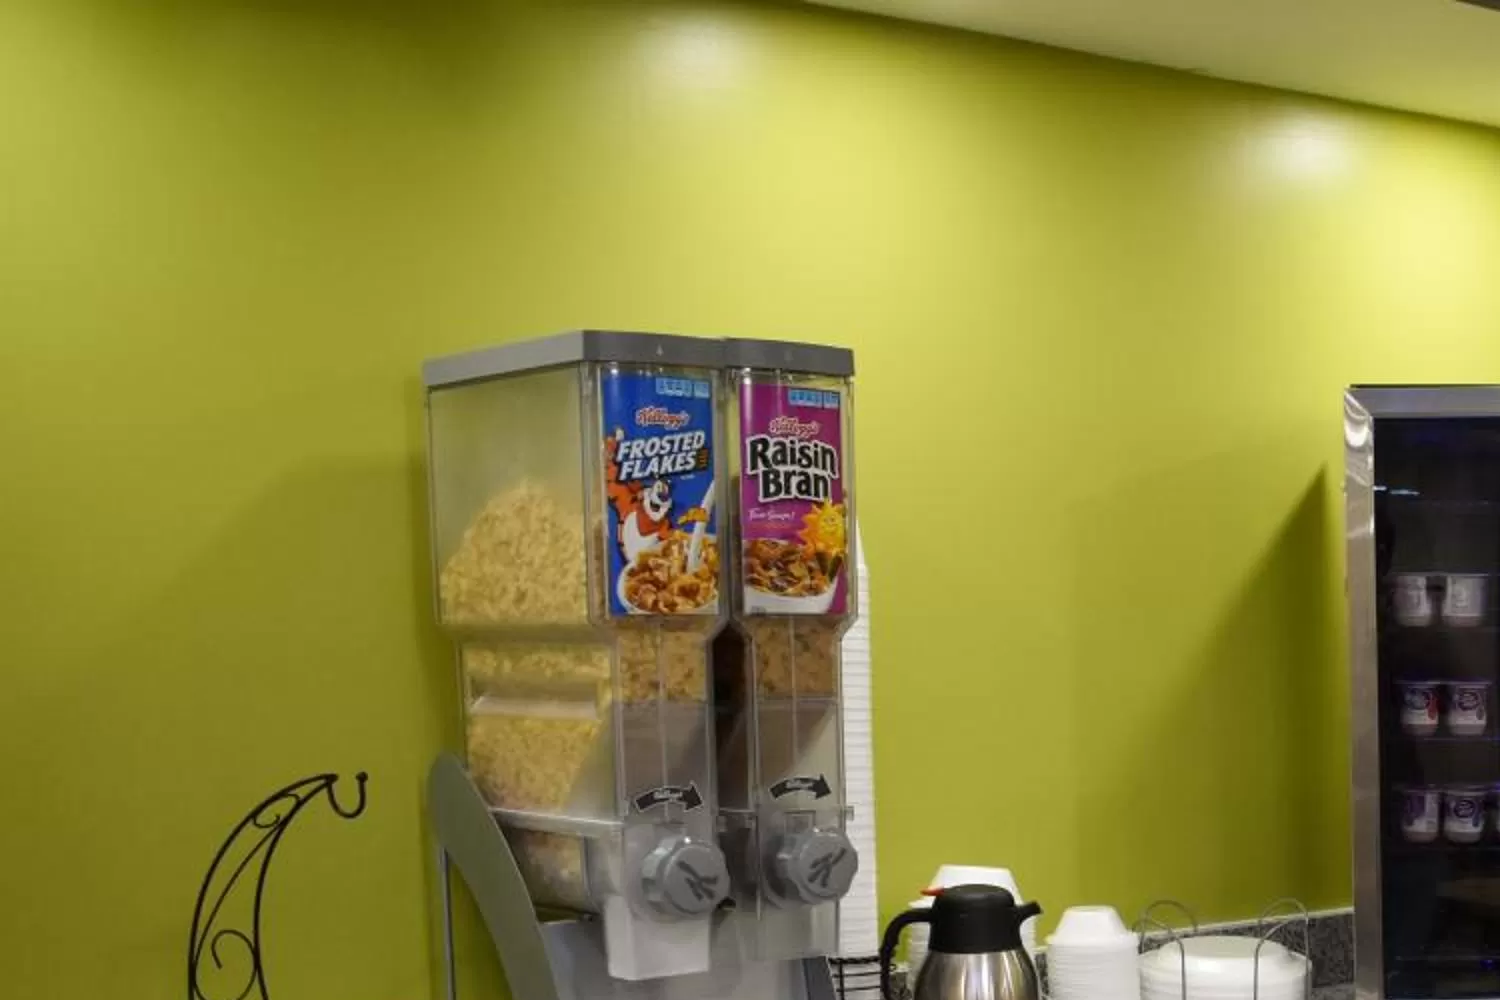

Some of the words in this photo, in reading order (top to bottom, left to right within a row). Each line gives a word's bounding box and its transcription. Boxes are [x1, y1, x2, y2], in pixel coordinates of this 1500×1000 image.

[616, 431, 705, 462] FROSTED
[747, 435, 837, 476] Raisin
[619, 451, 697, 480] FLAKES
[761, 467, 830, 500] Bran
